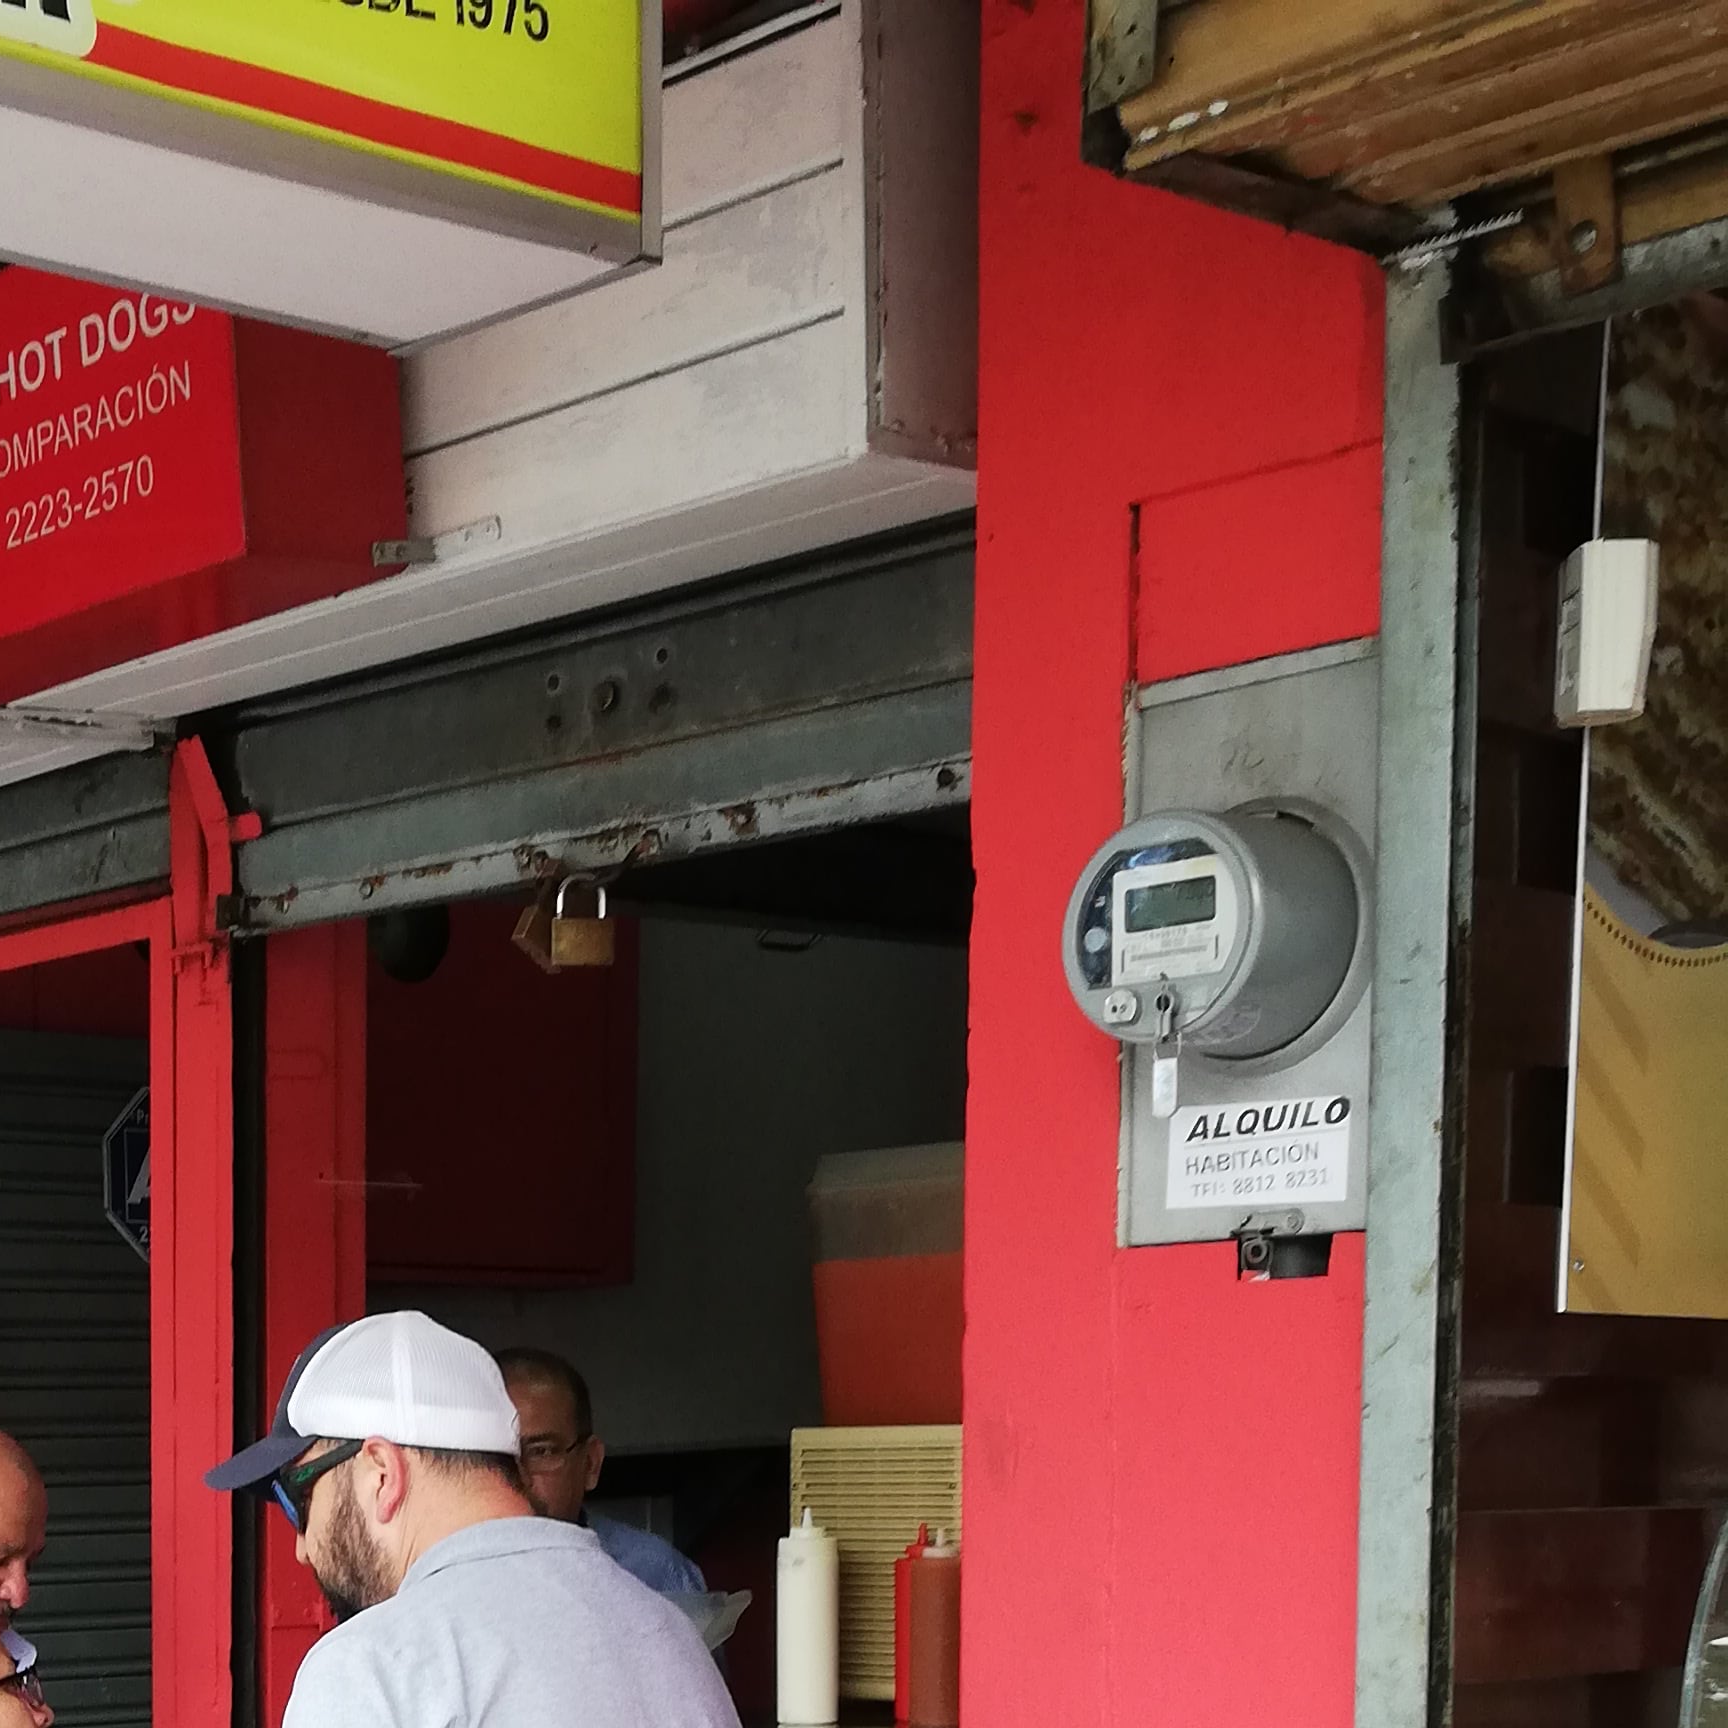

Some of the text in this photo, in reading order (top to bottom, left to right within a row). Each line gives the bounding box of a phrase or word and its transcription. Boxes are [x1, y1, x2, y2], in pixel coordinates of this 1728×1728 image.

[5, 454, 155, 550] 2223-2570
[1185, 1095, 1351, 1143] ALQUILO
[1184, 1138, 1320, 1176] HABITACIÓN
[1232, 1174, 1275, 1196] 8812
